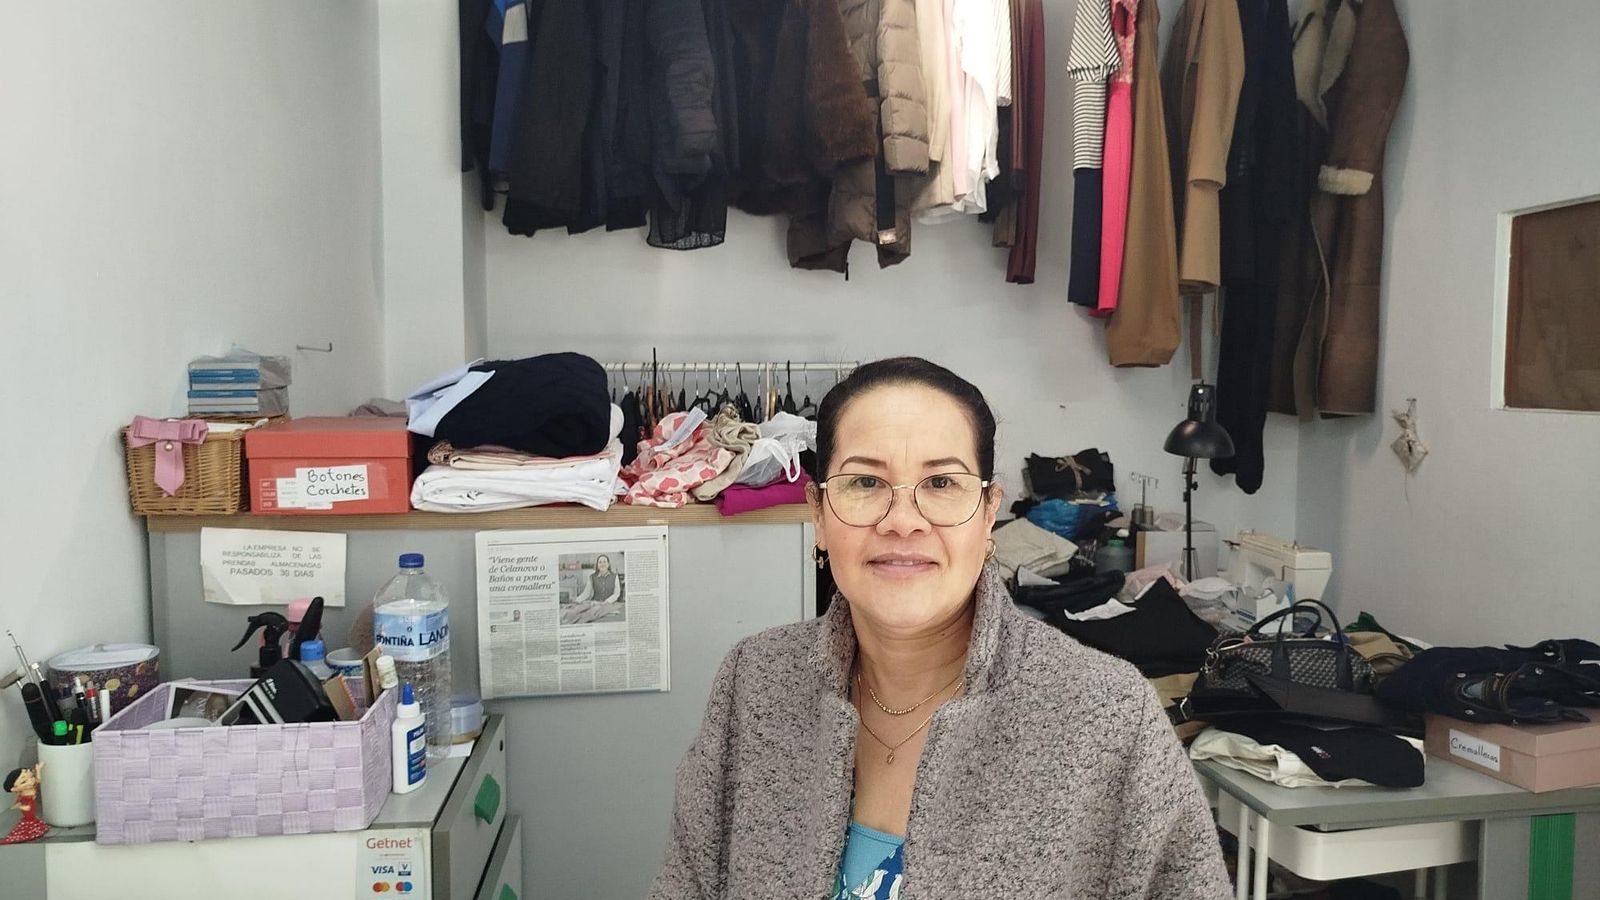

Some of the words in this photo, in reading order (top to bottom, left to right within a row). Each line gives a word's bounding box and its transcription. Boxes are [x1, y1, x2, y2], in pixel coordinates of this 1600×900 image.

[307, 469, 365, 483] Botones
[306, 484, 366, 496] Corchetes
[516, 556, 538, 564] gente
[230, 568, 273, 576] PASADOS
[523, 575, 547, 583] poner
[508, 581, 555, 591] cremallera"
[1451, 737, 1498, 763] Cremalleras
[366, 837, 412, 849] Getnet
[371, 865, 394, 874] VISA
